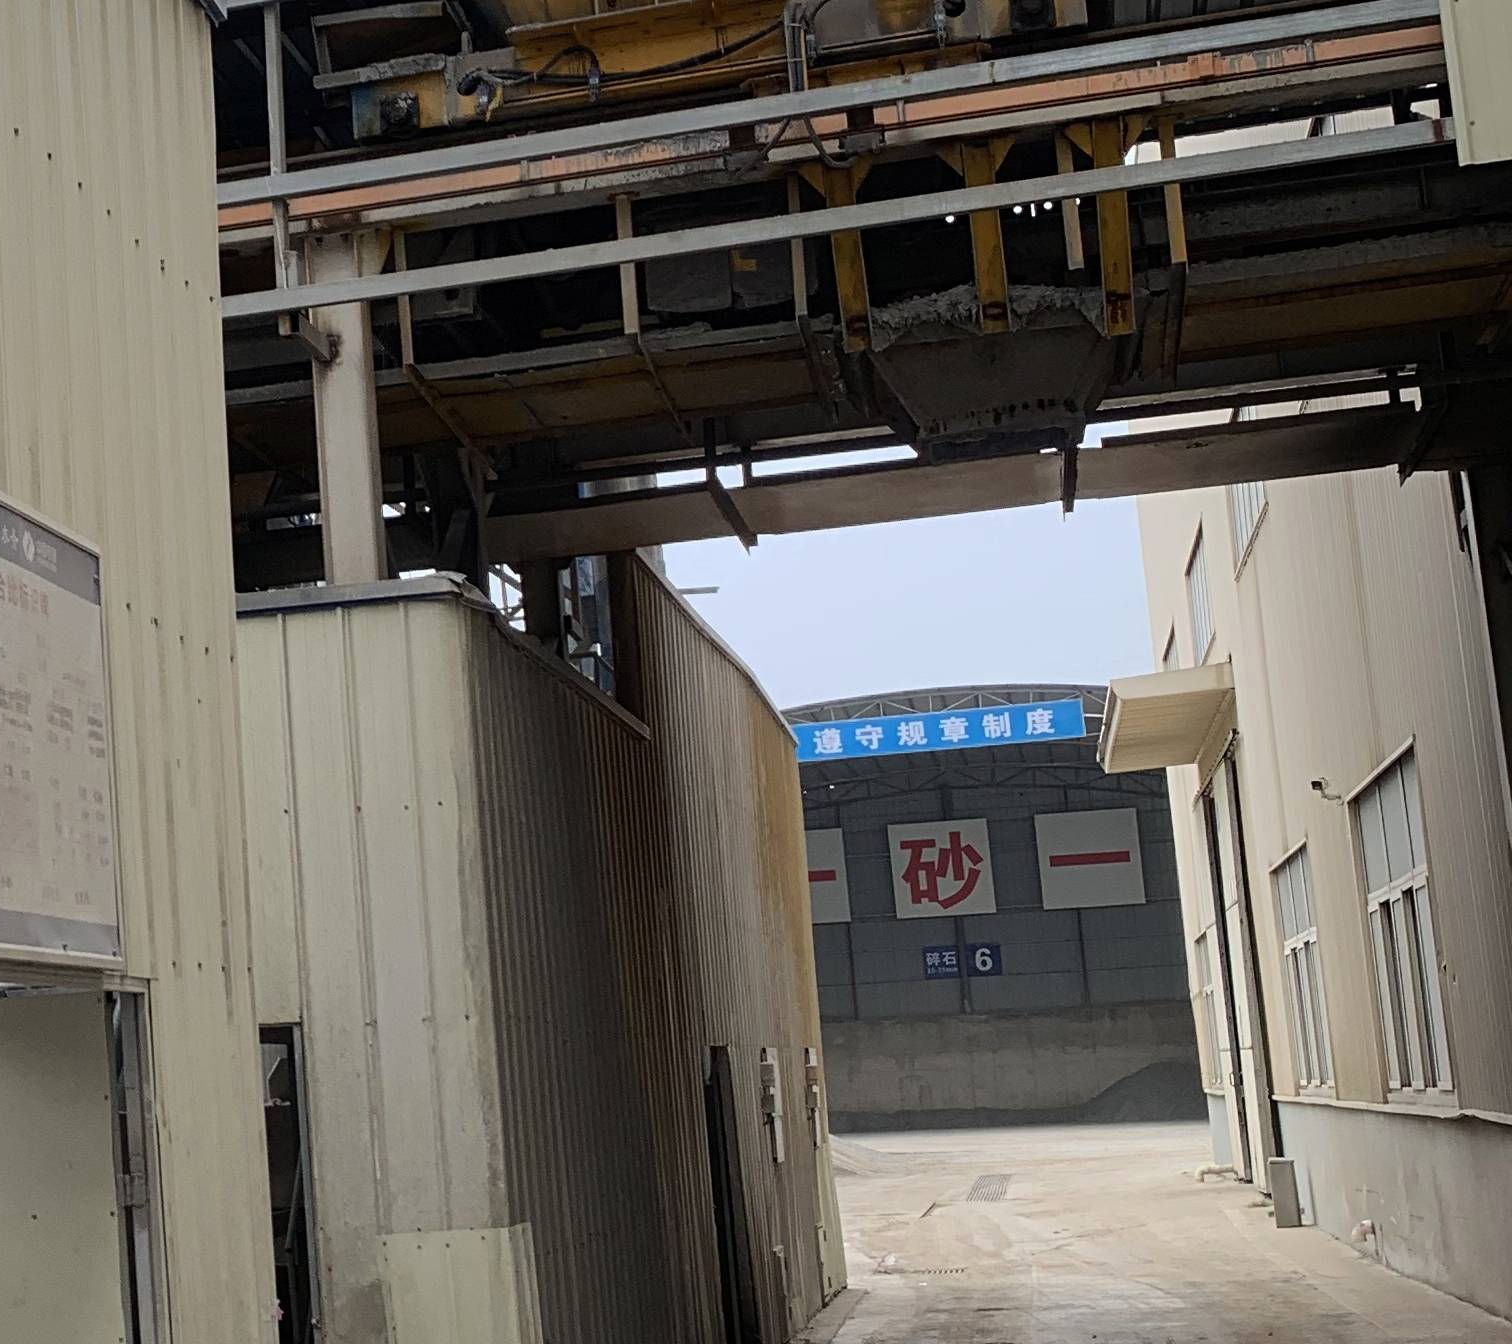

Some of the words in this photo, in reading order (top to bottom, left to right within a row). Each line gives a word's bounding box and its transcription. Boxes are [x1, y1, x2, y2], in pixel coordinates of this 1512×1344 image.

[813, 708, 1056, 755] 遵守规章制度
[899, 830, 984, 910] 砂
[975, 947, 993, 971] 6
